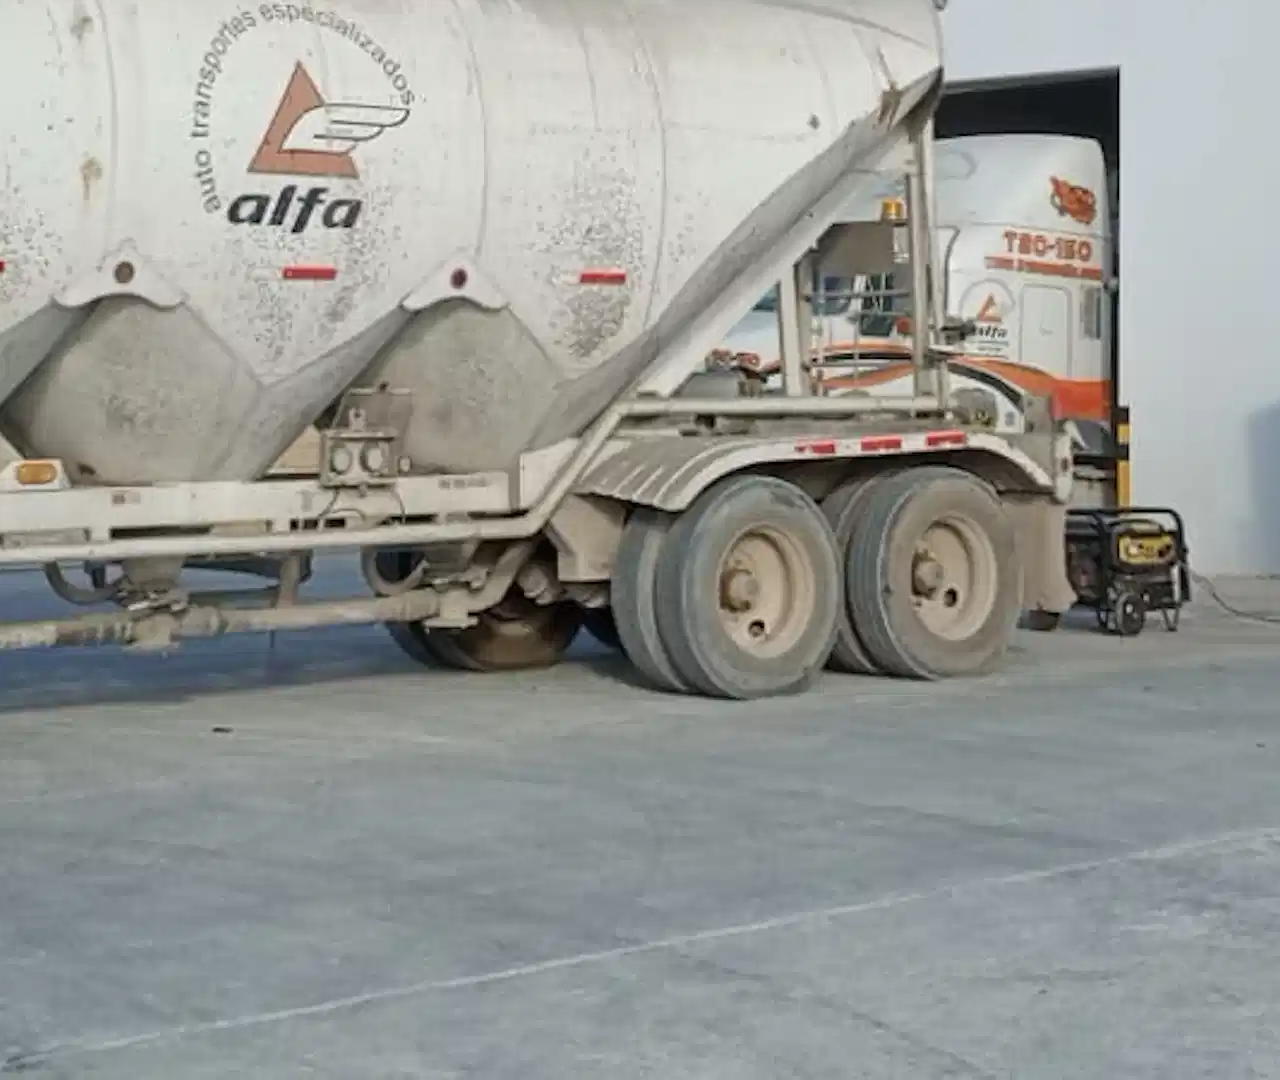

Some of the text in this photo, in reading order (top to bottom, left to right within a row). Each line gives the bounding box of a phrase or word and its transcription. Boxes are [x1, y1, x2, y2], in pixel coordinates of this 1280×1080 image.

[191, 4, 416, 214] auto transportes especializados
[227, 185, 363, 233] alfa
